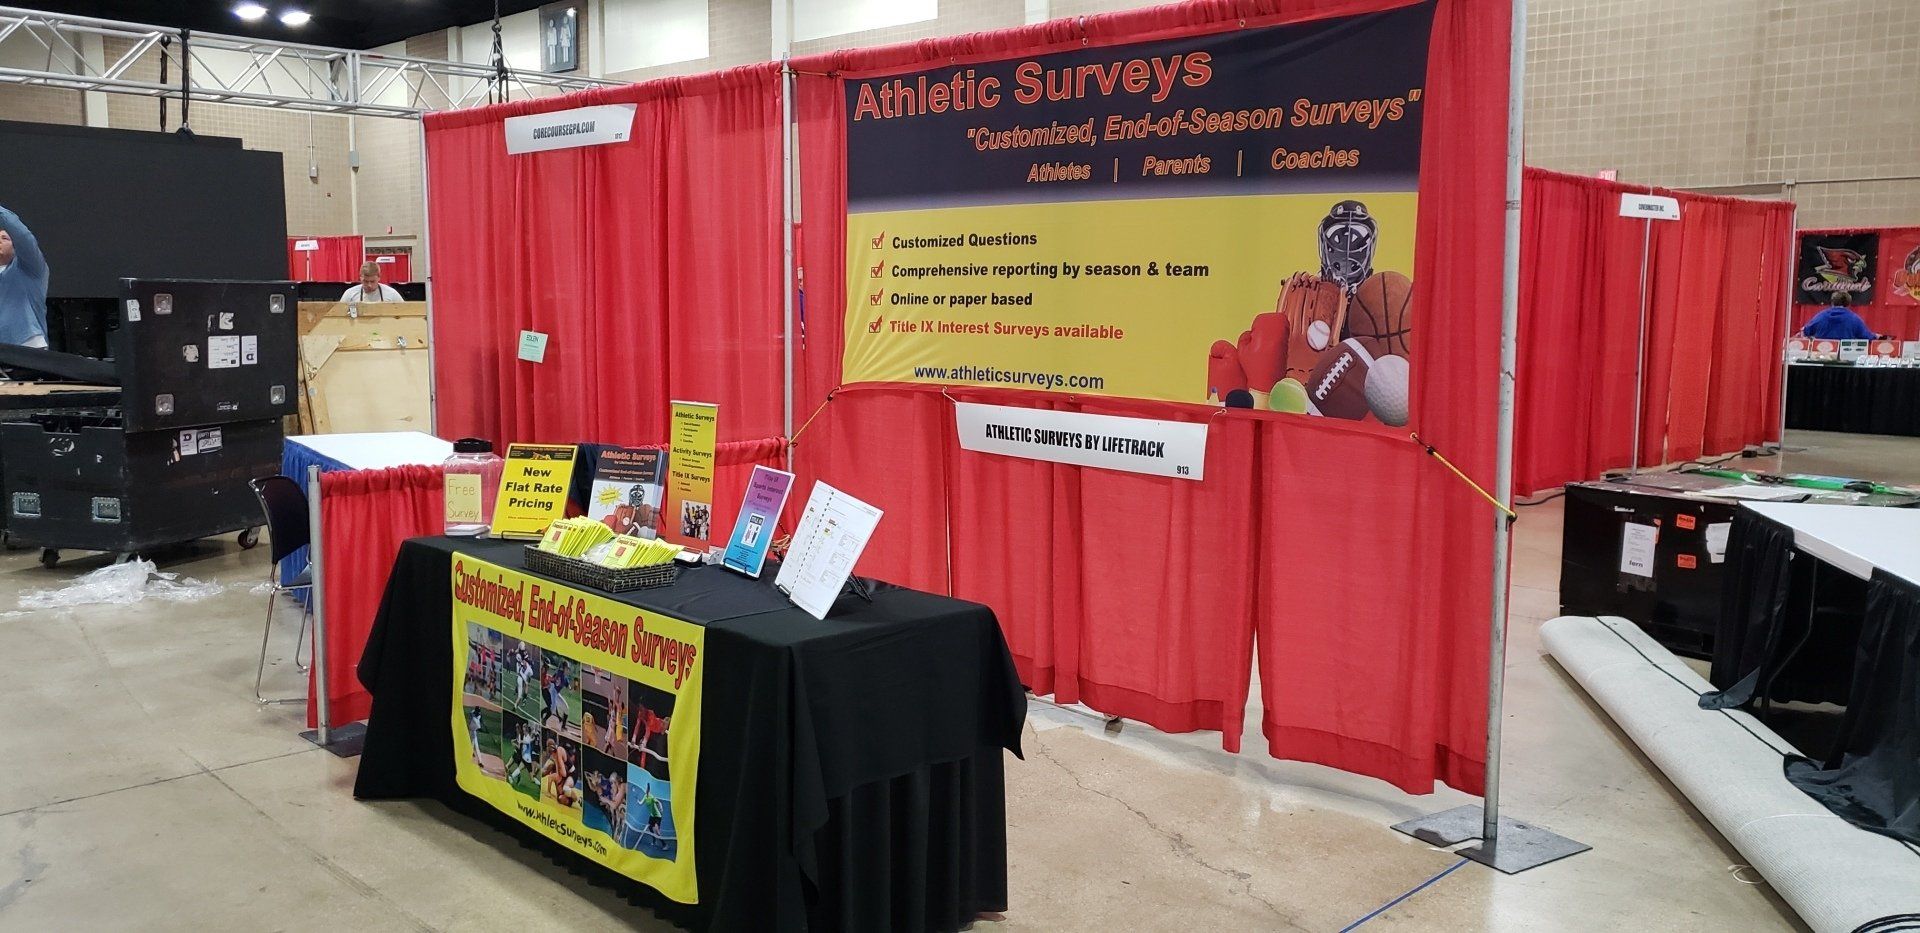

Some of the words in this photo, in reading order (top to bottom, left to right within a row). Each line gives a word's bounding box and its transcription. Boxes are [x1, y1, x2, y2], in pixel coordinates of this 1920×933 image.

[854, 70, 1001, 121] Athletic
[1014, 51, 1212, 104] Surveys
[967, 118, 1097, 151] "Customized,
[1104, 106, 1283, 141] End-of-Season
[1291, 89, 1421, 130] Surveys"
[533, 121, 595, 140] CORECOURSEGPA.COM
[1027, 162, 1091, 183] Athletes
[1142, 154, 1211, 176] Parents
[1271, 146, 1359, 170] Coaches
[892, 234, 964, 249] Customized
[968, 232, 1037, 247] Questions
[891, 263, 988, 280] Comprehensive
[992, 262, 1058, 279] reporting
[1062, 262, 1080, 279] by
[1084, 264, 1141, 276] season
[1147, 262, 1160, 277] &
[1165, 262, 1209, 277] team
[890, 293, 929, 305] Online
[932, 295, 946, 305] or
[949, 294, 987, 308] paper
[991, 292, 1033, 306] based
[889, 320, 916, 333] Title
[920, 320, 934, 333] IX
[937, 321, 990, 334] Interest
[993, 322, 1049, 339] Surveys
[1054, 323, 1124, 339] available
[914, 365, 1104, 389] www.athleticsurveys.com
[675, 411, 694, 420] Athletic
[695, 413, 715, 423] Surveys
[985, 423, 1032, 443] ATHLETIC
[1034, 428, 1082, 449] SURVEYS
[1085, 434, 1101, 451] BY
[1102, 435, 1165, 458] LIFETRACK
[601, 450, 631, 461] Athletic
[631, 452, 656, 462] Surveys
[673, 447, 691, 456] Activity
[693, 449, 712, 459] Surveys
[523, 466, 552, 477] New
[690, 473, 711, 483] Surveys
[1176, 464, 1190, 476] 913
[448, 479, 476, 496] Free
[505, 481, 530, 492] Flat
[533, 482, 563, 493] Rate
[448, 501, 480, 520] Survey
[508, 497, 553, 511] Pricing
[455, 560, 525, 634] Customized,
[528, 584, 628, 658] End-of-Season
[631, 616, 697, 690] Surveys
